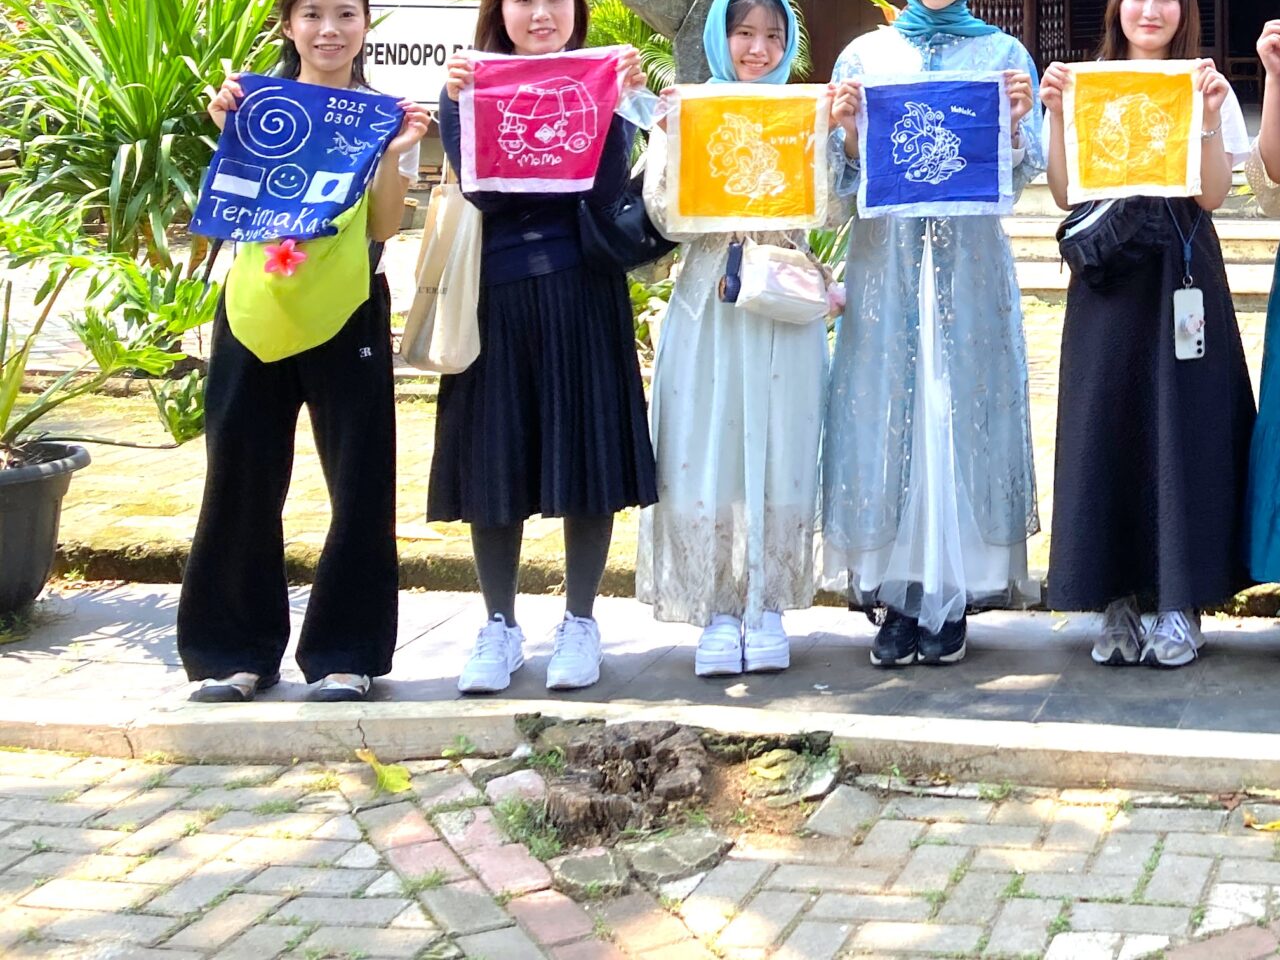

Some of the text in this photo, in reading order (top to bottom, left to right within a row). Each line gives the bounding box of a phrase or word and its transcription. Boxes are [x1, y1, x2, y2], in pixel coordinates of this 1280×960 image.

[364, 42, 447, 67] PENDOPO
[326, 96, 368, 114] 2025
[323, 111, 361, 128] 0301
